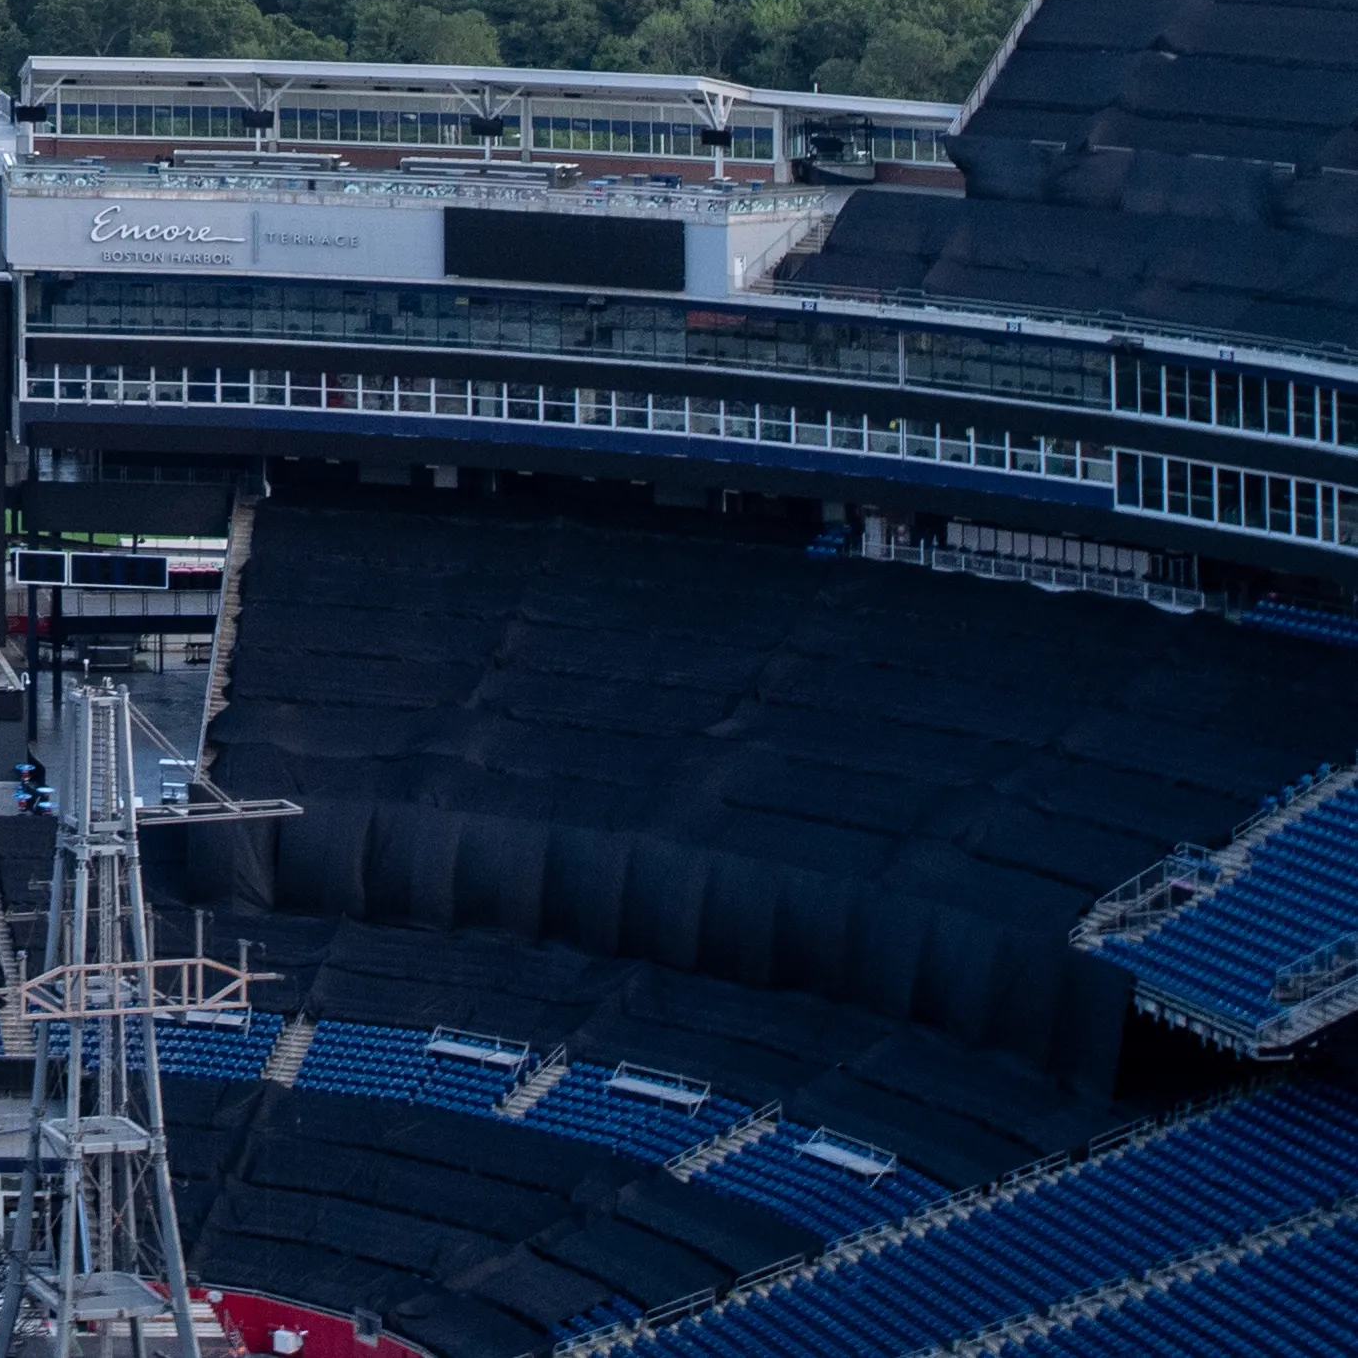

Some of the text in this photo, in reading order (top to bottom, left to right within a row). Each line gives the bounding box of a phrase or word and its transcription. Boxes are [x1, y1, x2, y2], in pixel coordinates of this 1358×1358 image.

[90, 205, 246, 242] Encore
[266, 232, 360, 247] TERRACE
[103, 250, 233, 264] BOSTON HARBOR
